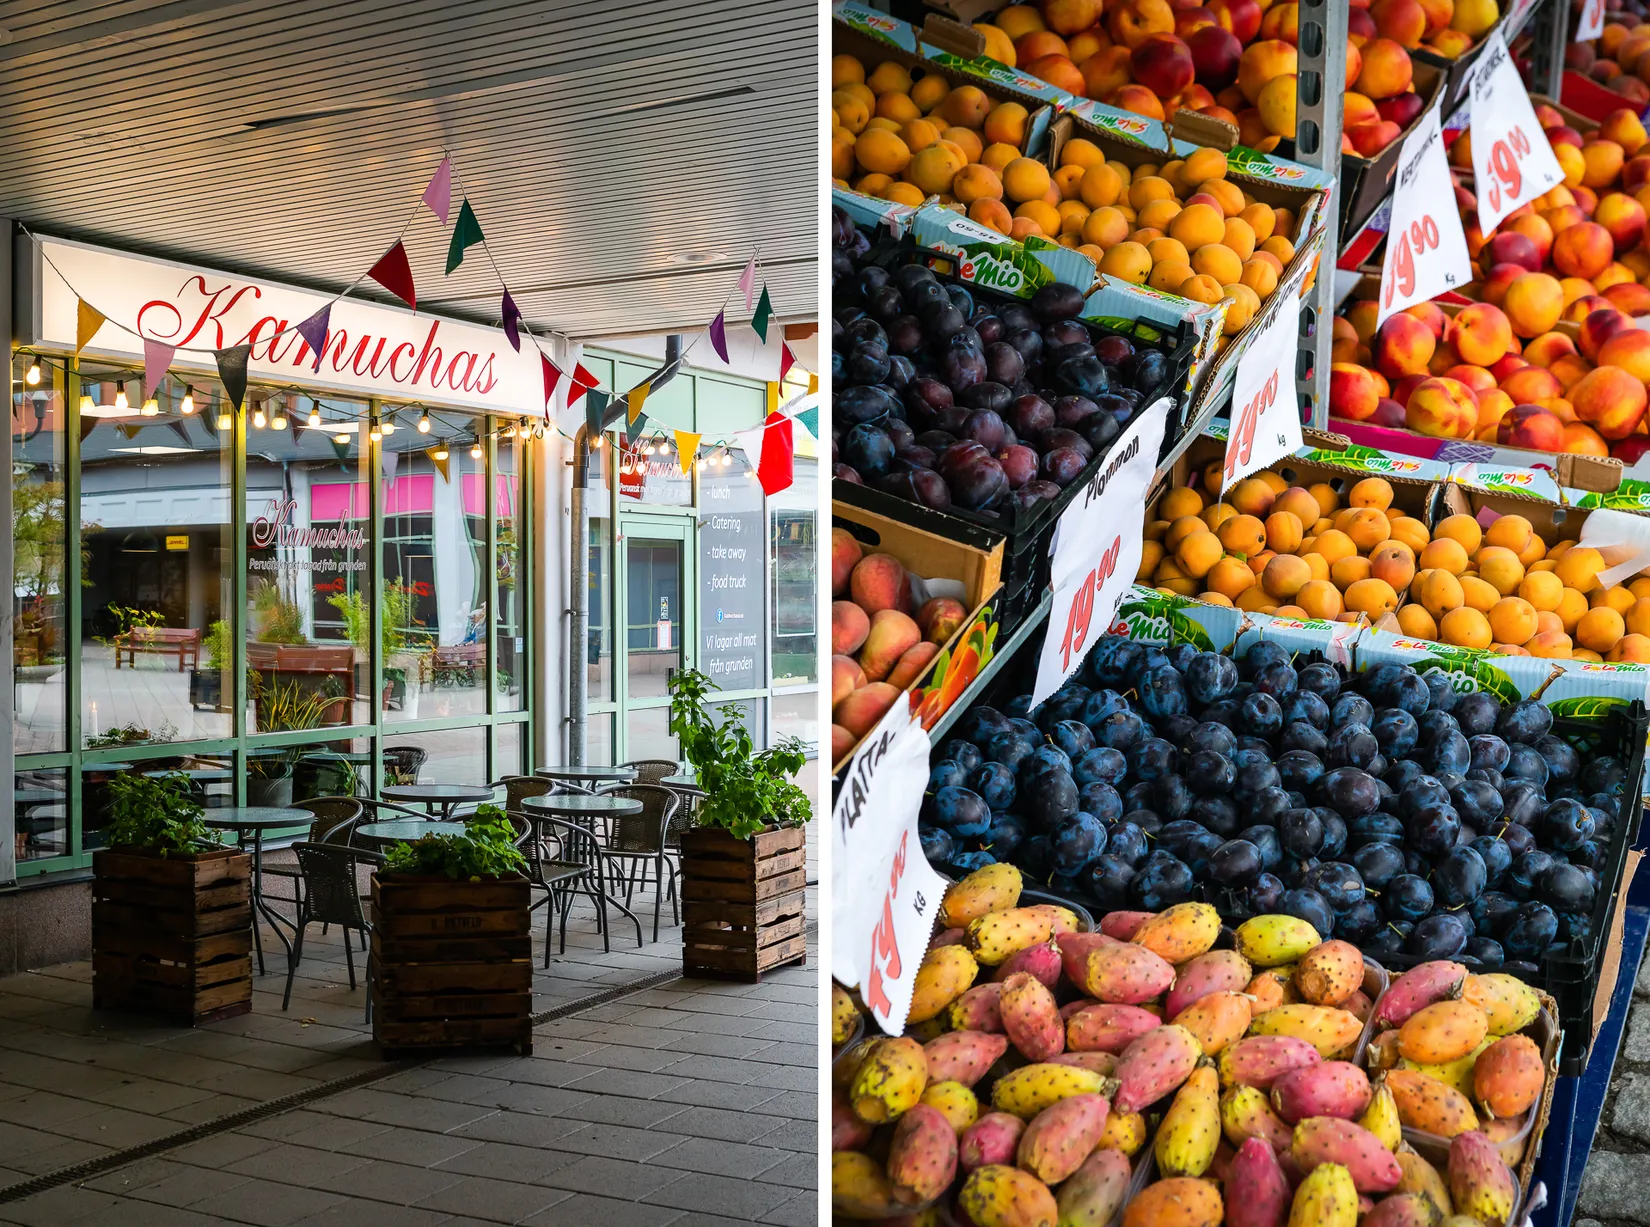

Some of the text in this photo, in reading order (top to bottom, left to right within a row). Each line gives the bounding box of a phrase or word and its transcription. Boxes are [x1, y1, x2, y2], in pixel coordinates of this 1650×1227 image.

[136, 275, 499, 394] Kamuchas
[1085, 434, 1139, 509] Plommon
[711, 485, 731, 500] lunch
[252, 499, 365, 550] Kamuchas
[712, 515, 741, 533] Catering
[712, 544, 746, 562] take away
[711, 574, 746, 591] food truck
[1059, 568, 1096, 674] 19
[706, 633, 757, 652] Vi lagar all mat
[709, 656, 753, 677] från grunden
[913, 891, 927, 917] KG
